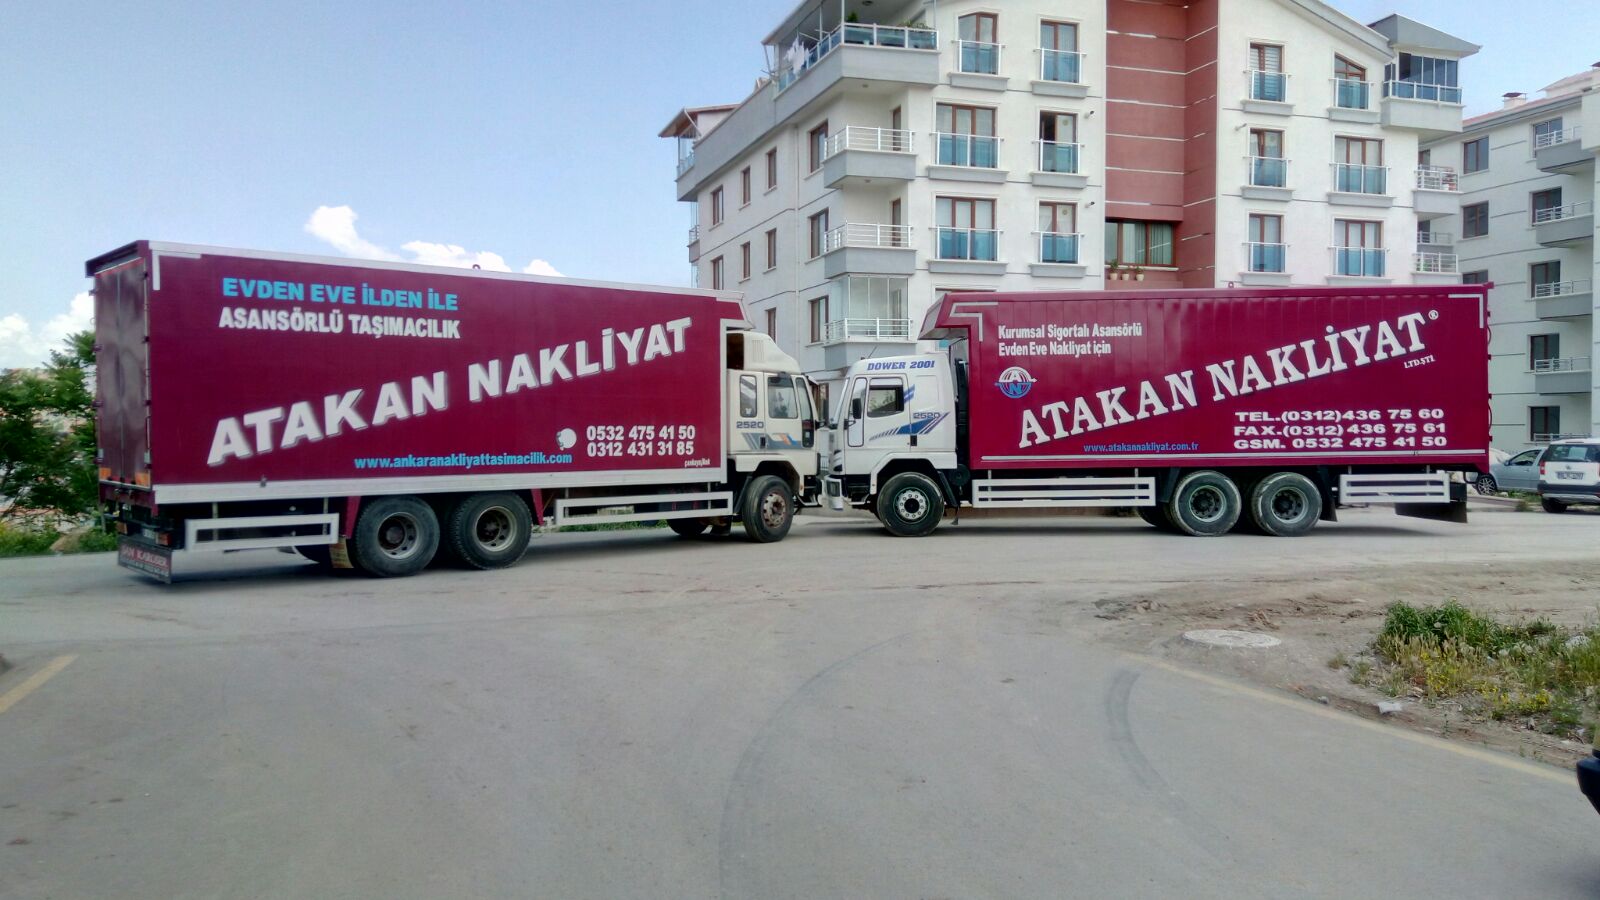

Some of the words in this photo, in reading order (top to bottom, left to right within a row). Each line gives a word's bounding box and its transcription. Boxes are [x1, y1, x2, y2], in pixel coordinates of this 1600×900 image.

[223, 278, 304, 300] EVDEN
[310, 284, 355, 304] EVE
[362, 283, 422, 308] İLDEN
[428, 288, 458, 310] İLE
[219, 307, 343, 333] ASANSÖRLÜ
[348, 308, 460, 339] TAŞIMACILIK
[999, 325, 1044, 338] Kurumsal
[1048, 324, 1089, 341] Sigortalı
[1092, 323, 1142, 337] Asansörlü
[999, 342, 1028, 356] Evden
[1030, 342, 1047, 355] Eve
[1050, 339, 1091, 357] Nakliyat
[1093, 340, 1111, 356] için
[867, 362, 906, 370] DOWER
[1018, 370, 1198, 449] ATAKAN
[1206, 312, 1426, 401] NAKLİYAT
[207, 371, 448, 466] ATAKAN
[469, 317, 692, 402] NAKLİYAT
[912, 411, 941, 419] 2520
[1388, 409, 1412, 419] 75
[1419, 409, 1444, 418] 60
[587, 426, 624, 440] 0532
[629, 426, 655, 440] 475
[659, 426, 674, 439] 41
[679, 425, 695, 439] 50
[1347, 424, 1385, 434] 436
[1393, 424, 1416, 433] 75
[1423, 423, 1445, 433] 61
[587, 442, 623, 457] 0312
[627, 442, 652, 456] 431
[658, 441, 672, 455] 31
[677, 441, 694, 455] 85
[1083, 441, 1199, 453] www.atakannakliyat.com.tr
[1234, 439, 1285, 449] GSM.
[1292, 438, 1343, 448] 0532
[1350, 437, 1386, 447] 475
[1393, 437, 1415, 446] 41
[1422, 437, 1447, 446] 50
[355, 452, 572, 468] www.ankaranakliyattasimacilik.com
